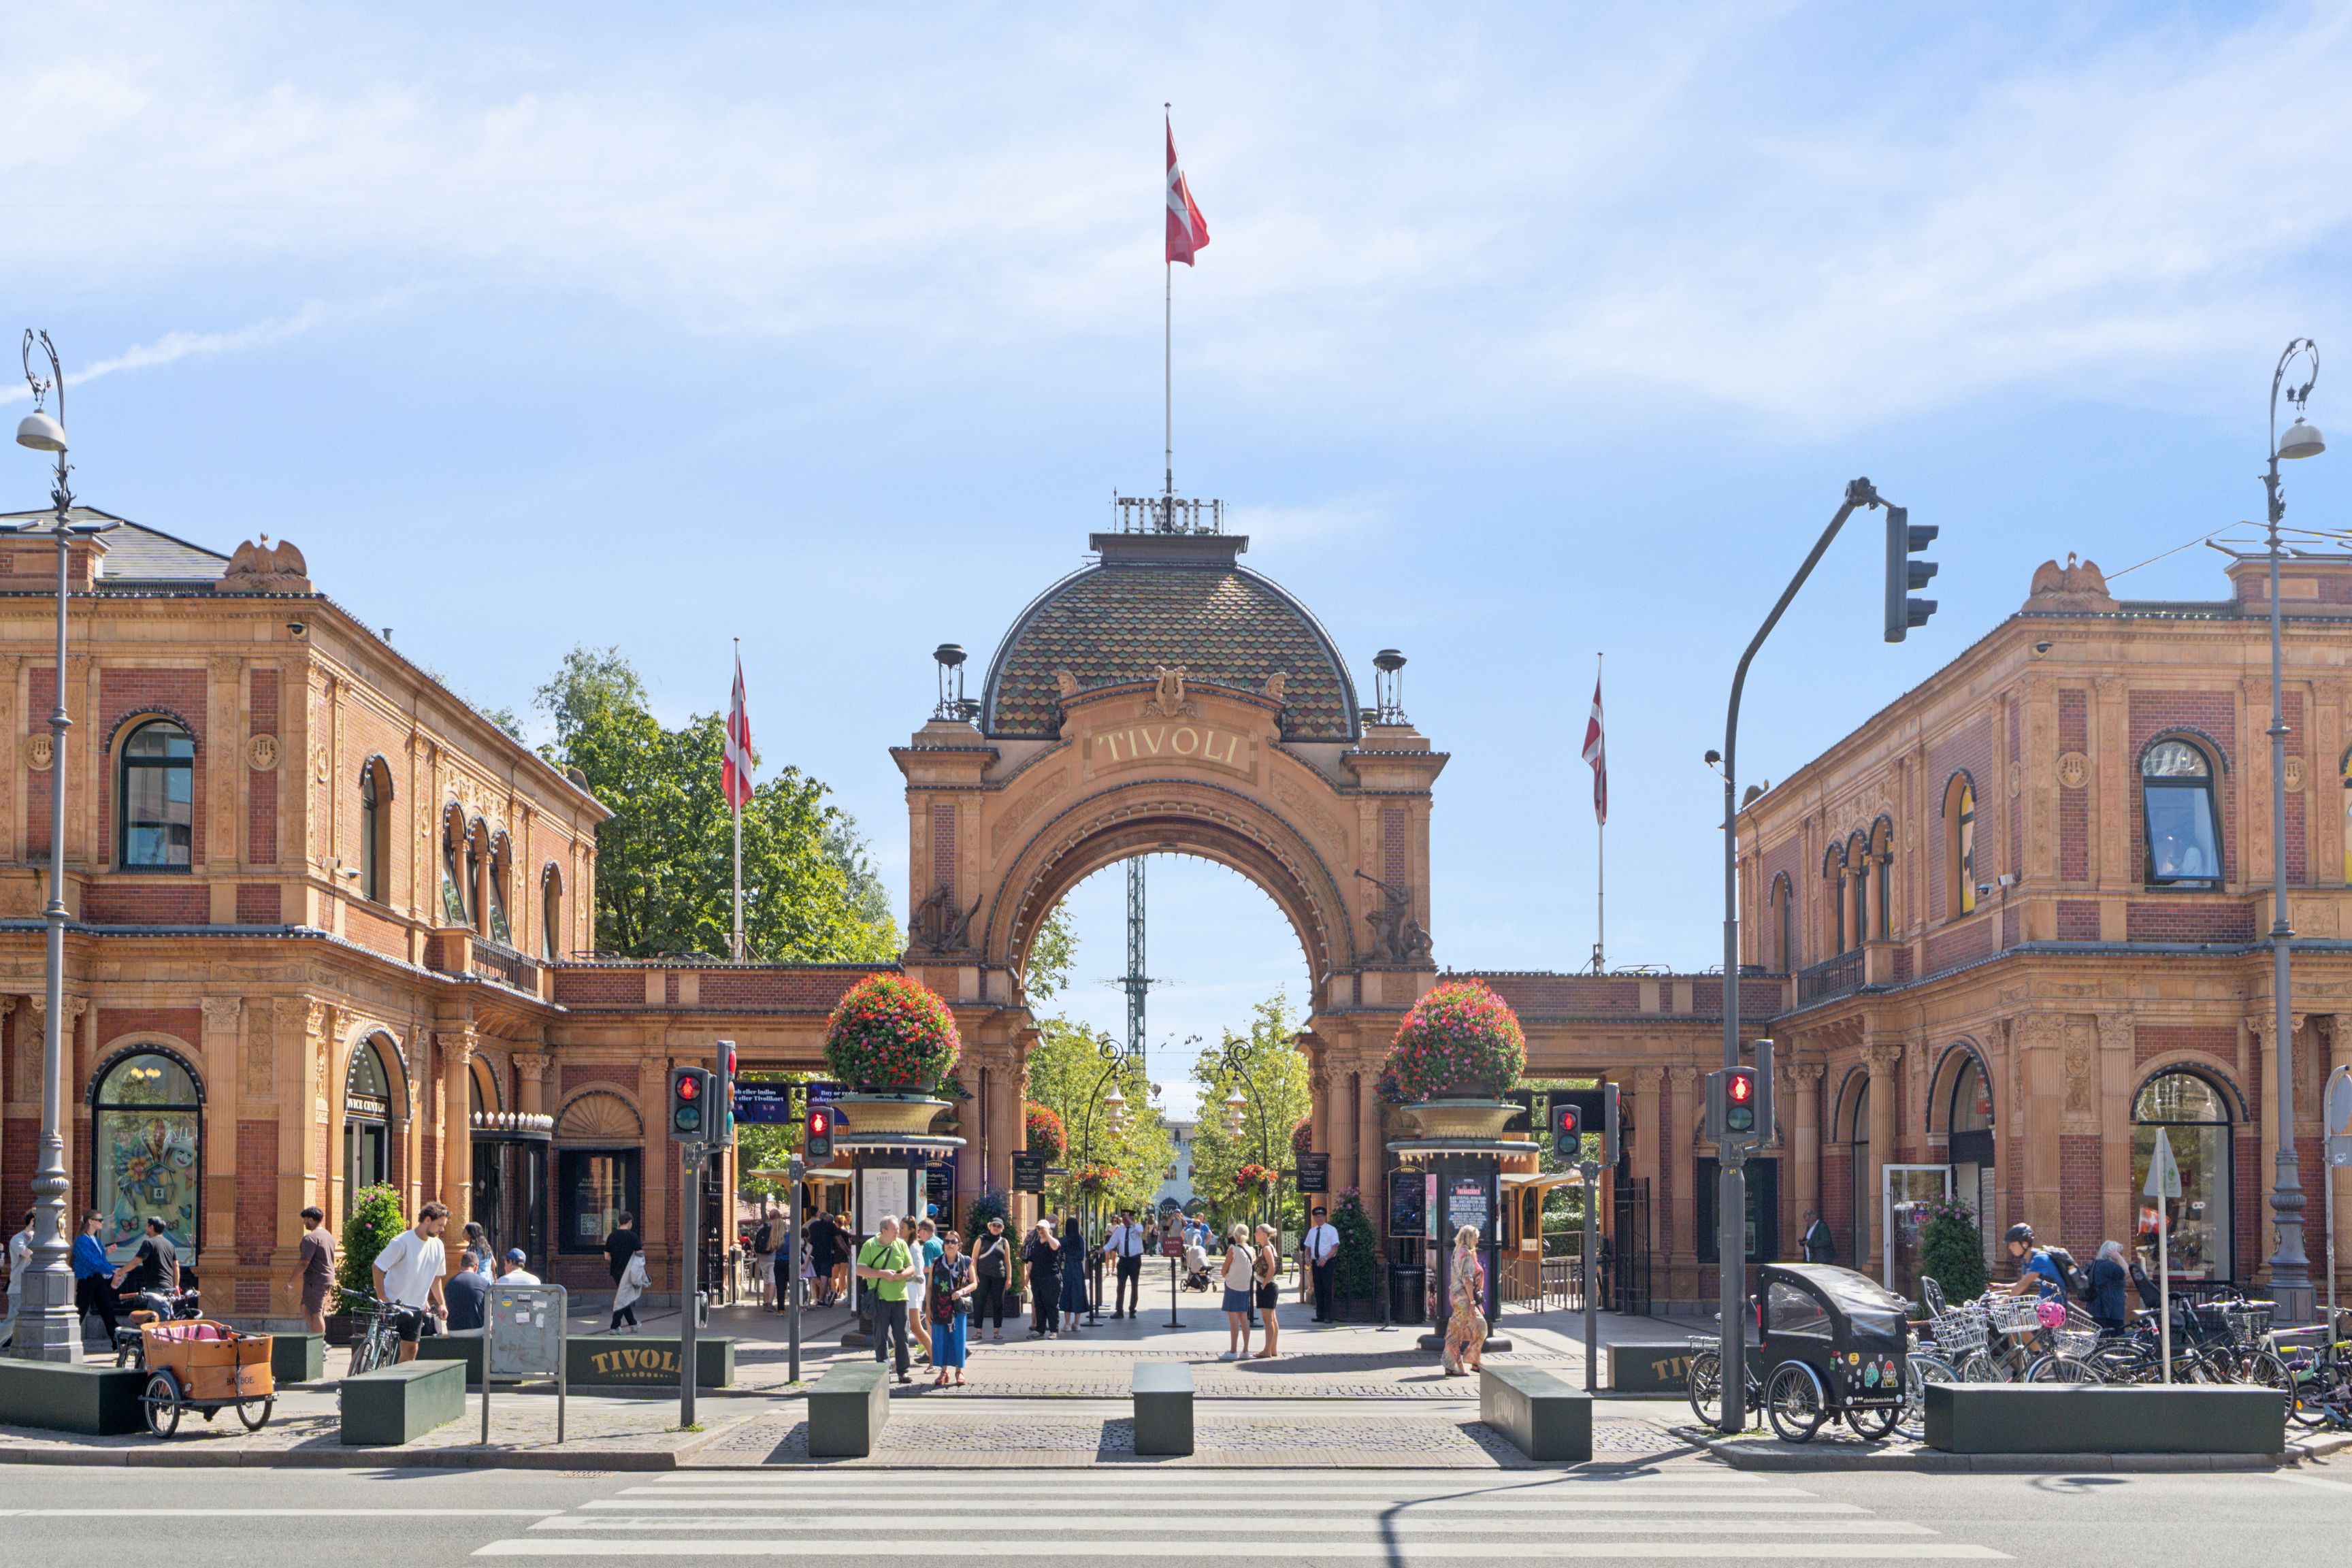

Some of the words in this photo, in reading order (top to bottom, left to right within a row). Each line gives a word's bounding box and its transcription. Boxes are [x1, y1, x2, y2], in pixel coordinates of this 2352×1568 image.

[1118, 497, 1219, 534] TIVOLI
[1098, 727, 1238, 764] TIVOLI
[227, 1376, 255, 1386] BABOE
